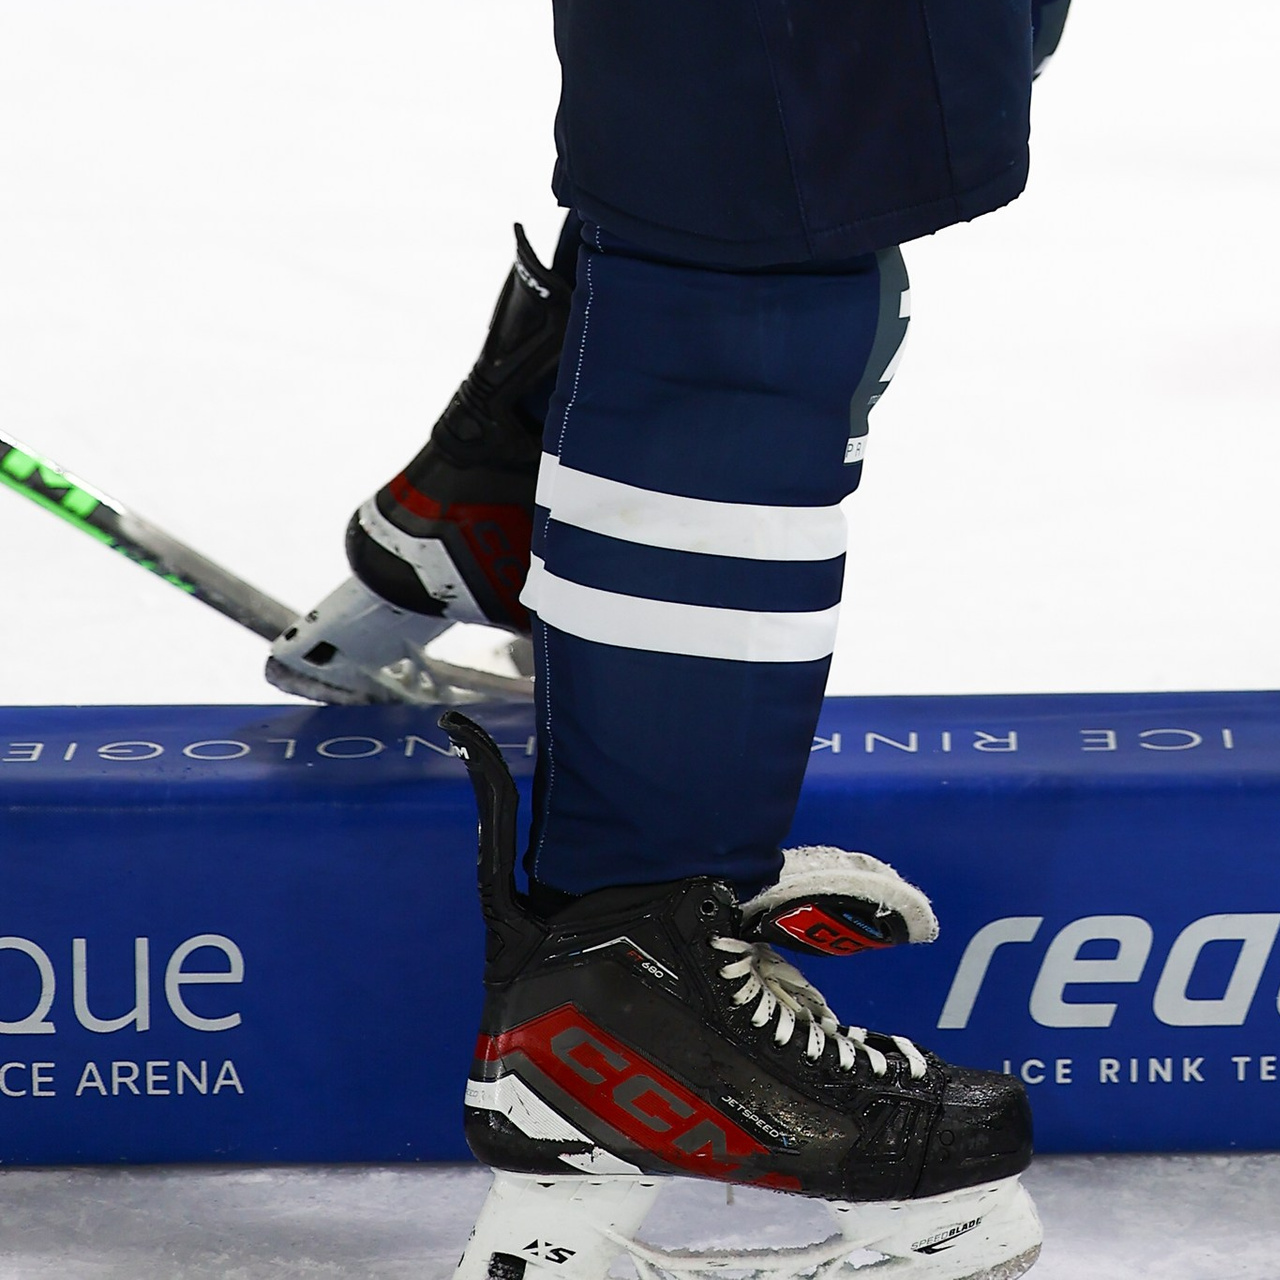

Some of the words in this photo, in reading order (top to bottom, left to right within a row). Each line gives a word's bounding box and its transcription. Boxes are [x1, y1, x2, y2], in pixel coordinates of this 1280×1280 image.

[811, 731, 1018, 753] RINK
[1081, 728, 1234, 751] ICE
[641, 962, 664, 978] 680
[76, 1061, 244, 1095] ARENA
[1003, 1059, 1073, 1084] ICE
[1100, 1057, 1205, 1083] RINK
[720, 1095, 780, 1139] JETSPEED
